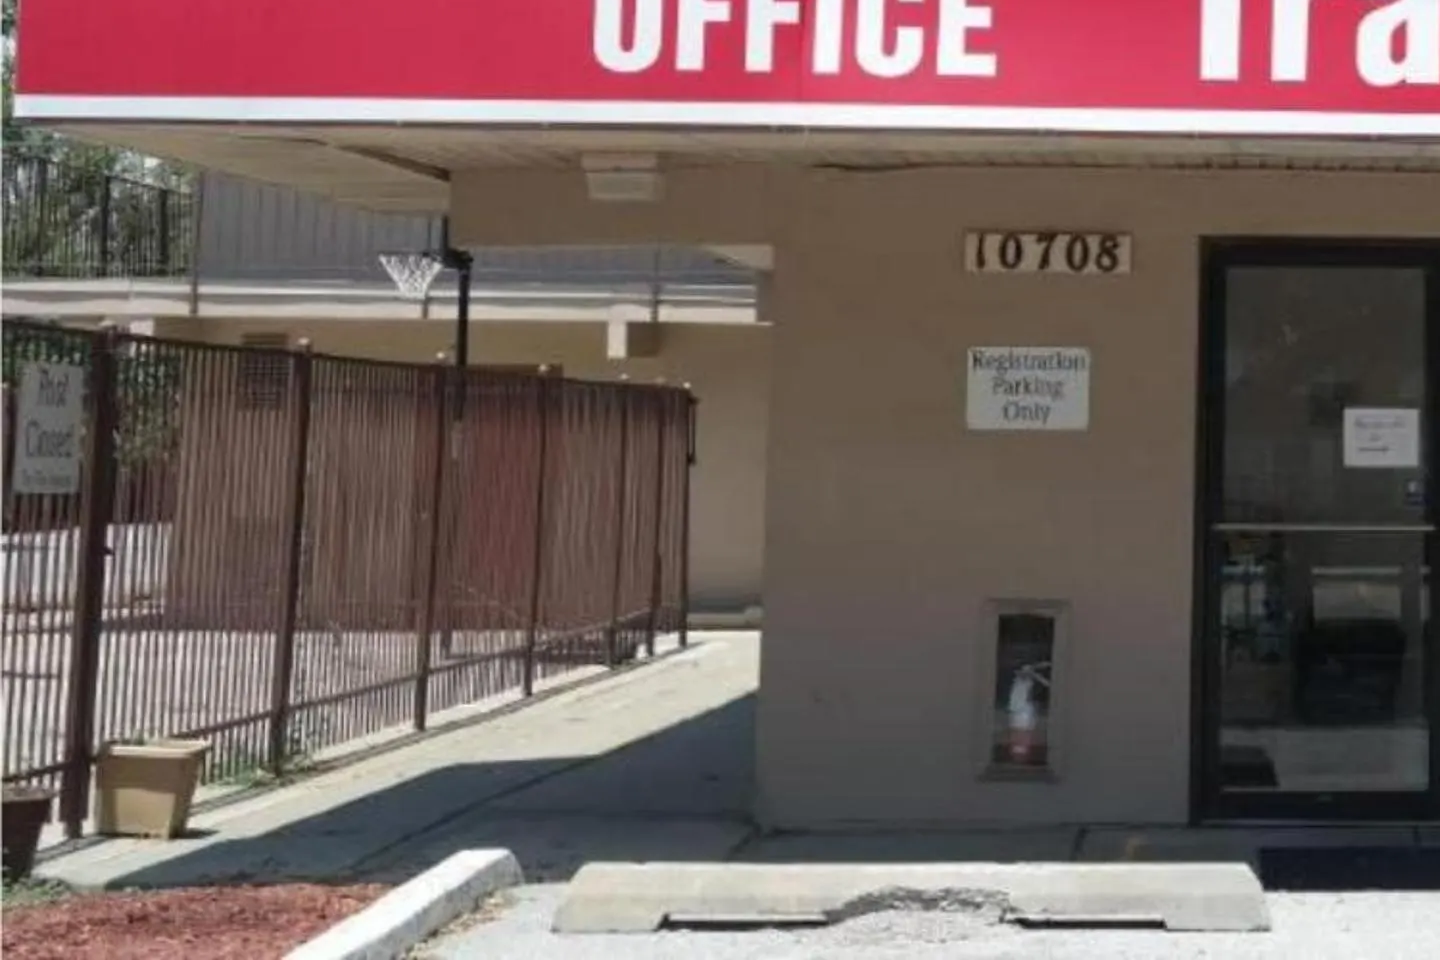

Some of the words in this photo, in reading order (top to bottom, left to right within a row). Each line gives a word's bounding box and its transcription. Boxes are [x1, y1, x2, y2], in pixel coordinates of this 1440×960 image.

[976, 231, 1120, 272] 10708
[972, 349, 1087, 375] Registration
[993, 375, 1065, 400] Parking
[1002, 400, 1052, 424] Only
